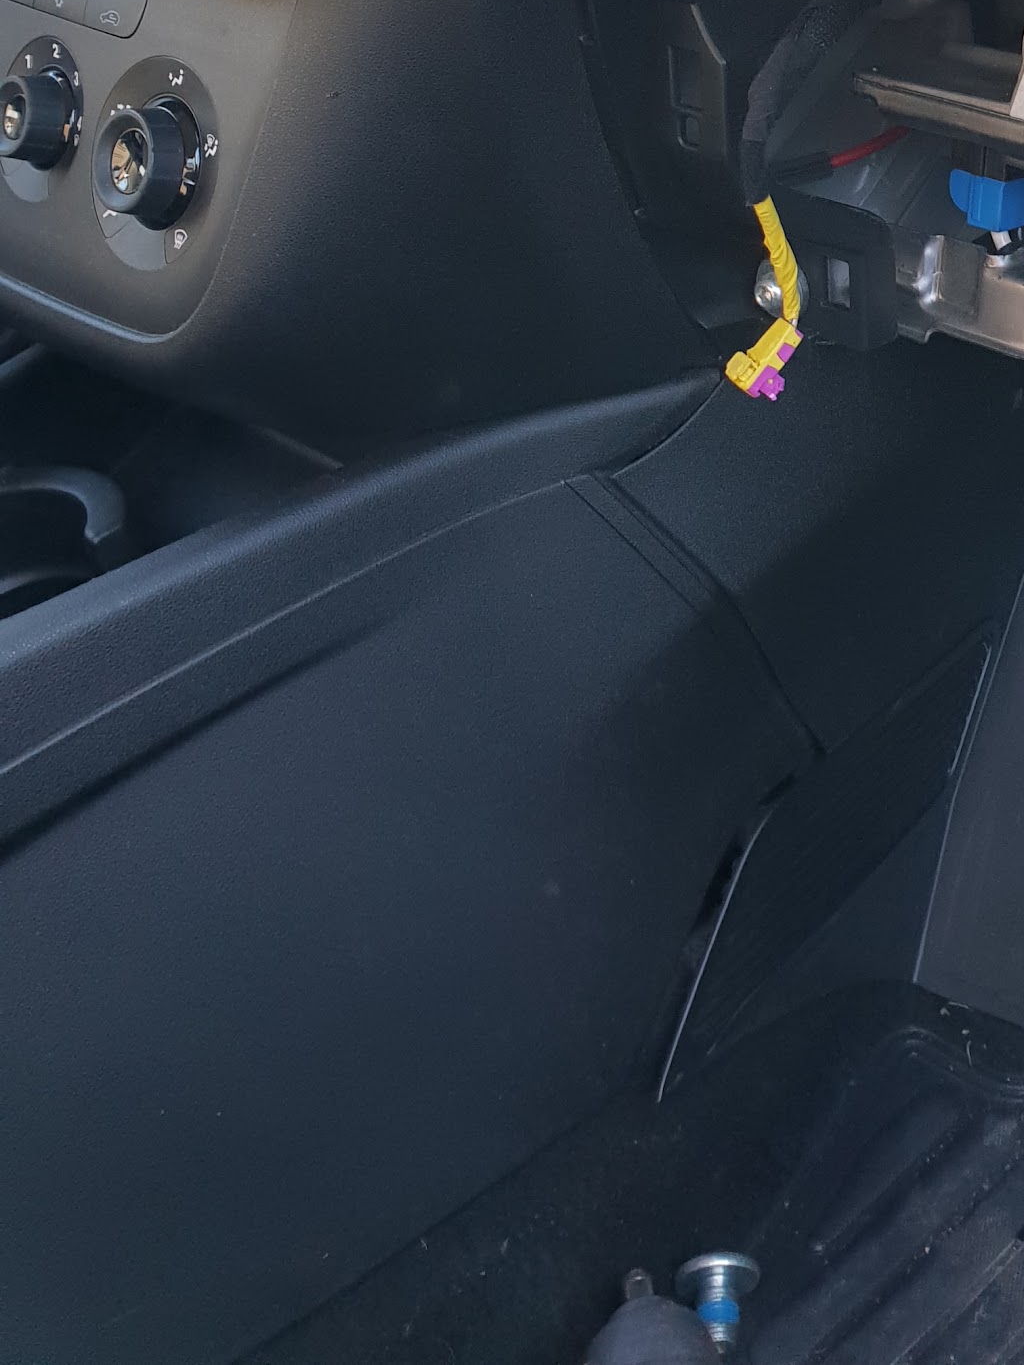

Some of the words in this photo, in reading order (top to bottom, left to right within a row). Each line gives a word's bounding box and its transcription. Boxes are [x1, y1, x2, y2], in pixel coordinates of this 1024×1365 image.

[52, 43, 60, 59] 2
[25, 54, 32, 69] 1
[73, 71, 79, 87] 3
